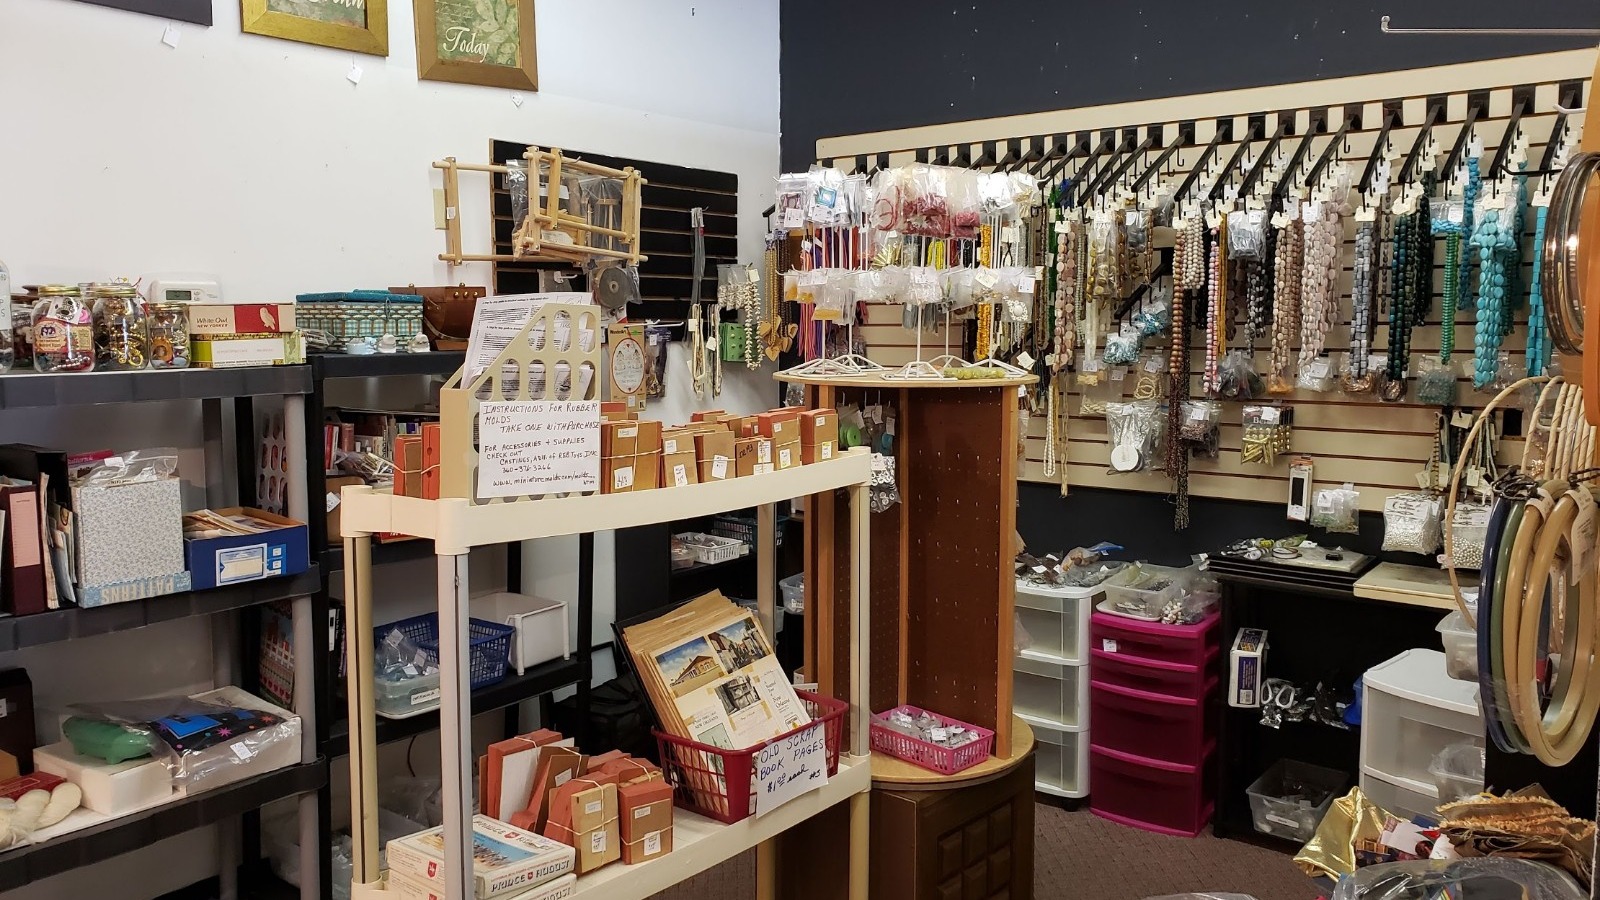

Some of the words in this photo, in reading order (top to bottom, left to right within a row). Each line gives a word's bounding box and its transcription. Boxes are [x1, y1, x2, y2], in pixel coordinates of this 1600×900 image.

[443, 26, 490, 63] Today
[483, 404, 543, 415] INSTRUCTIONS
[549, 403, 562, 412] FOR
[566, 402, 598, 412] RUBBER
[485, 415, 511, 425] MOLDS
[500, 423, 522, 433] TAKE
[525, 423, 543, 431] ONE
[484, 445, 497, 453] FOR
[502, 440, 541, 451] ACCESSORIES
[553, 437, 585, 445] SUPPLIES
[487, 452, 508, 460] CHECK
[101, 579, 174, 602] PATTERNS
[760, 744, 779, 763] OLD
[787, 725, 818, 750] SCRAP
[760, 756, 784, 781] BOOK
[793, 738, 824, 761] PAGES
[491, 874, 526, 893] PRINCE
[536, 860, 570, 878] AUGUST
